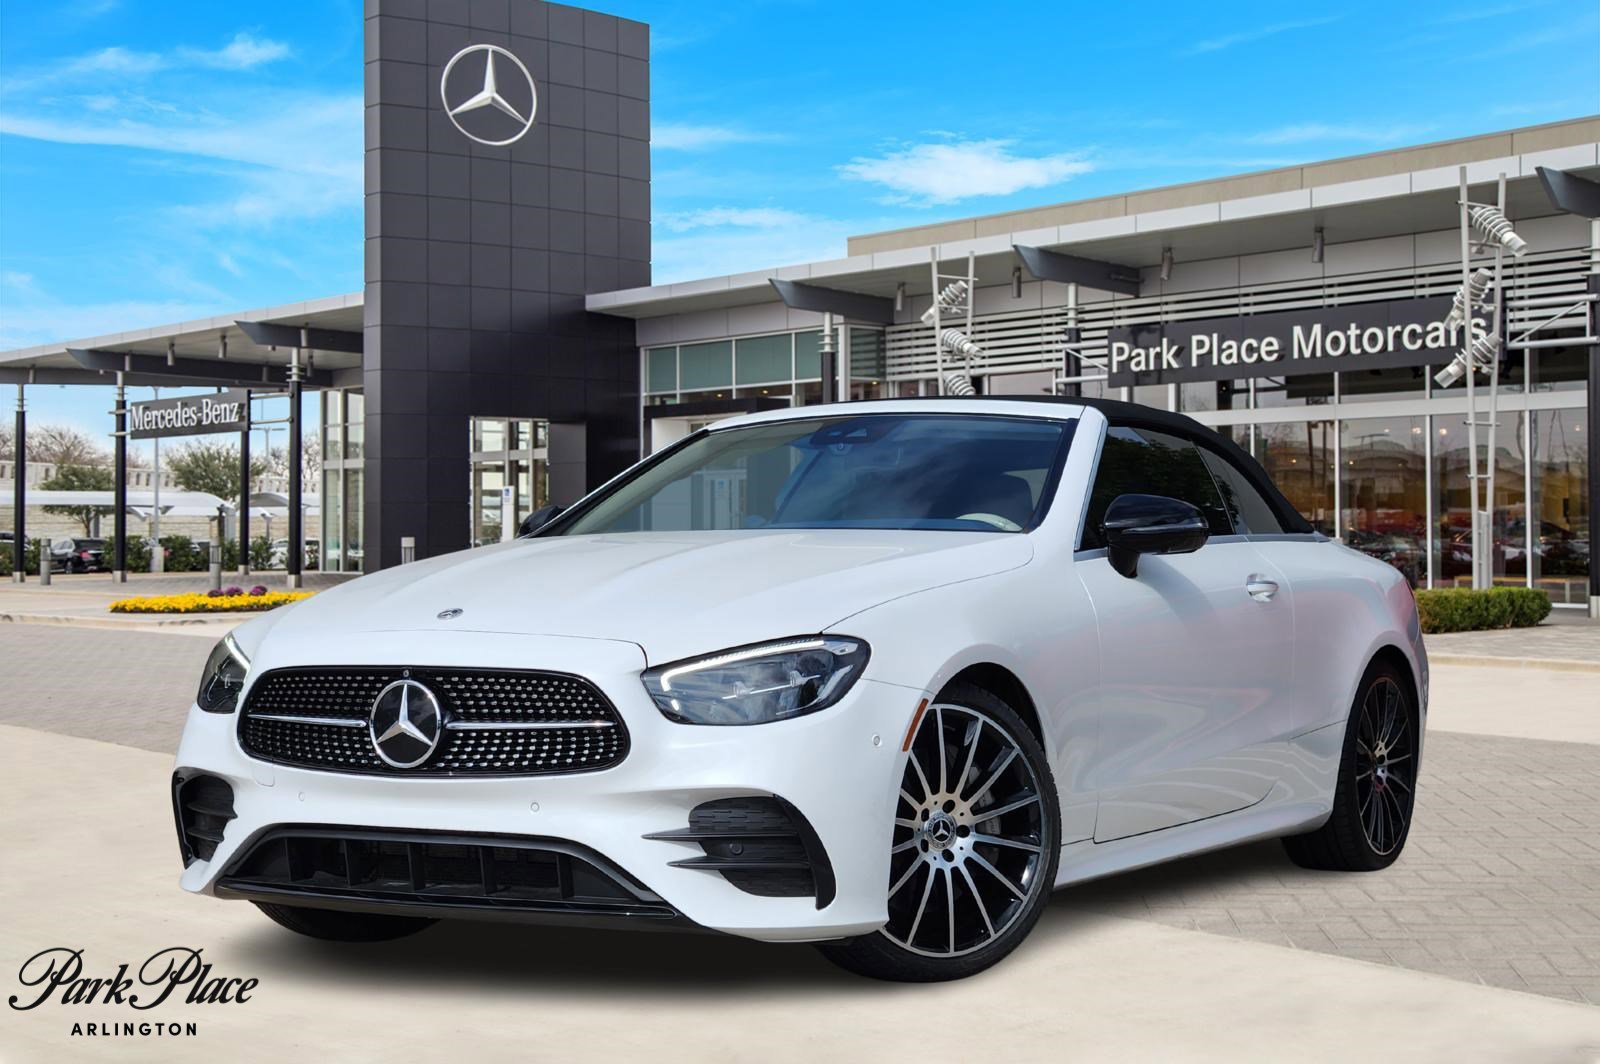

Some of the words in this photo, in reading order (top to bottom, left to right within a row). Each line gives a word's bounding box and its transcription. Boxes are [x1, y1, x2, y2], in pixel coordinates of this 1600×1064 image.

[1111, 338, 1179, 373] Park
[1190, 333, 1280, 367] Place
[131, 398, 239, 430] Mercedes-Benz
